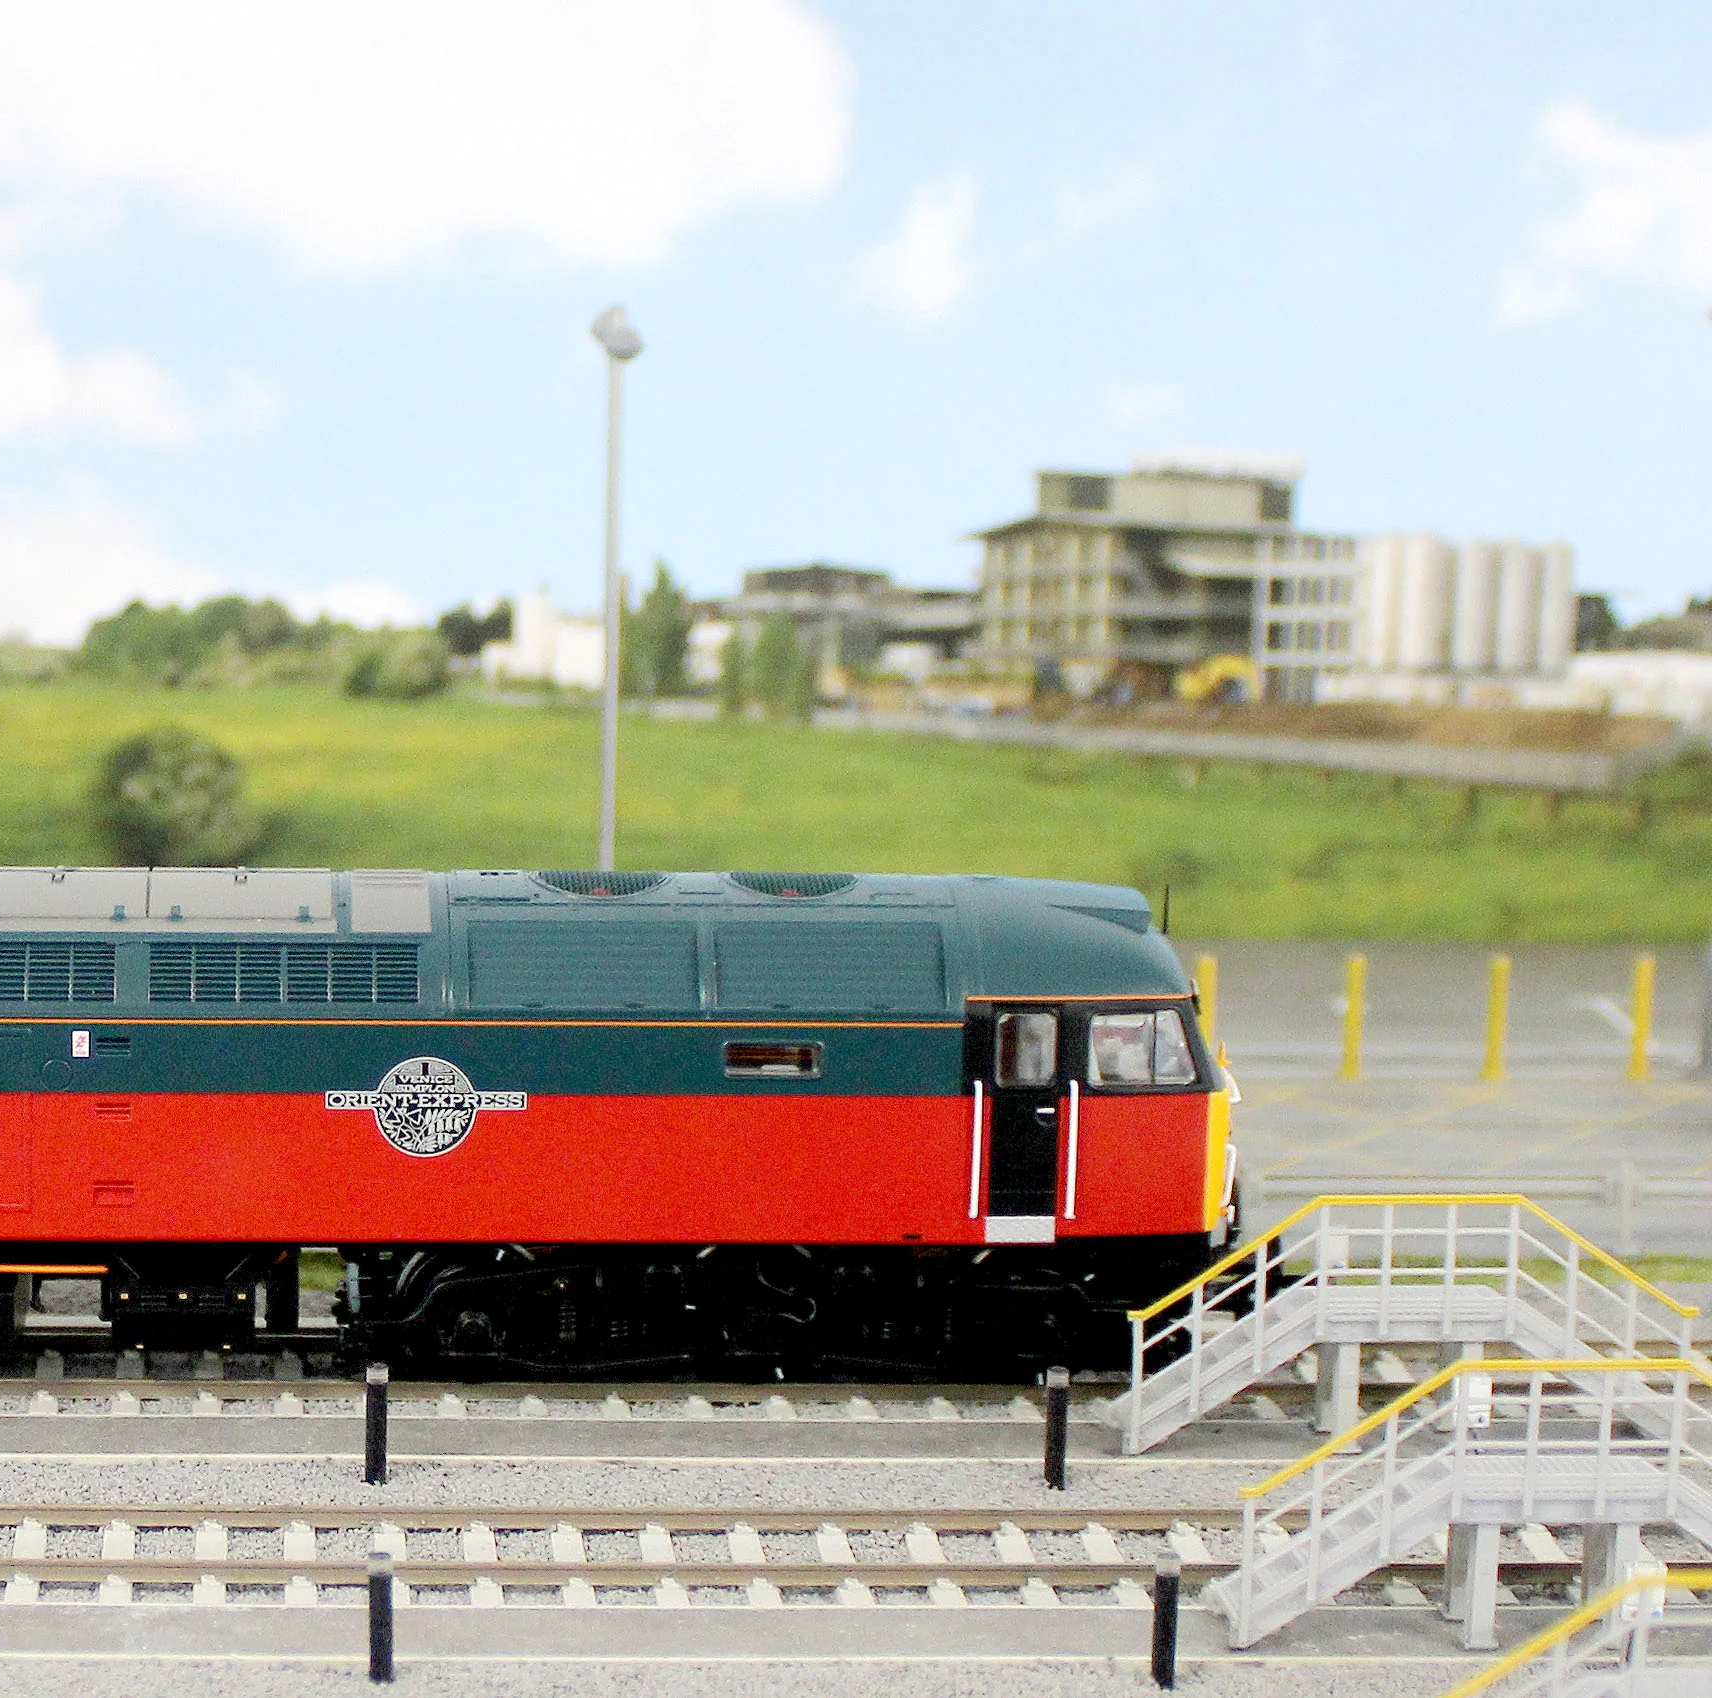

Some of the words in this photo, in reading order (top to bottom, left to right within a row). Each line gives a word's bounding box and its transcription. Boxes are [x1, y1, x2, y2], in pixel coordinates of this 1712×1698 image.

[398, 1075, 454, 1084] VENICE
[396, 1084, 456, 1093] SIMPLON
[328, 1093, 524, 1108] ORIENT-EXPRESS
